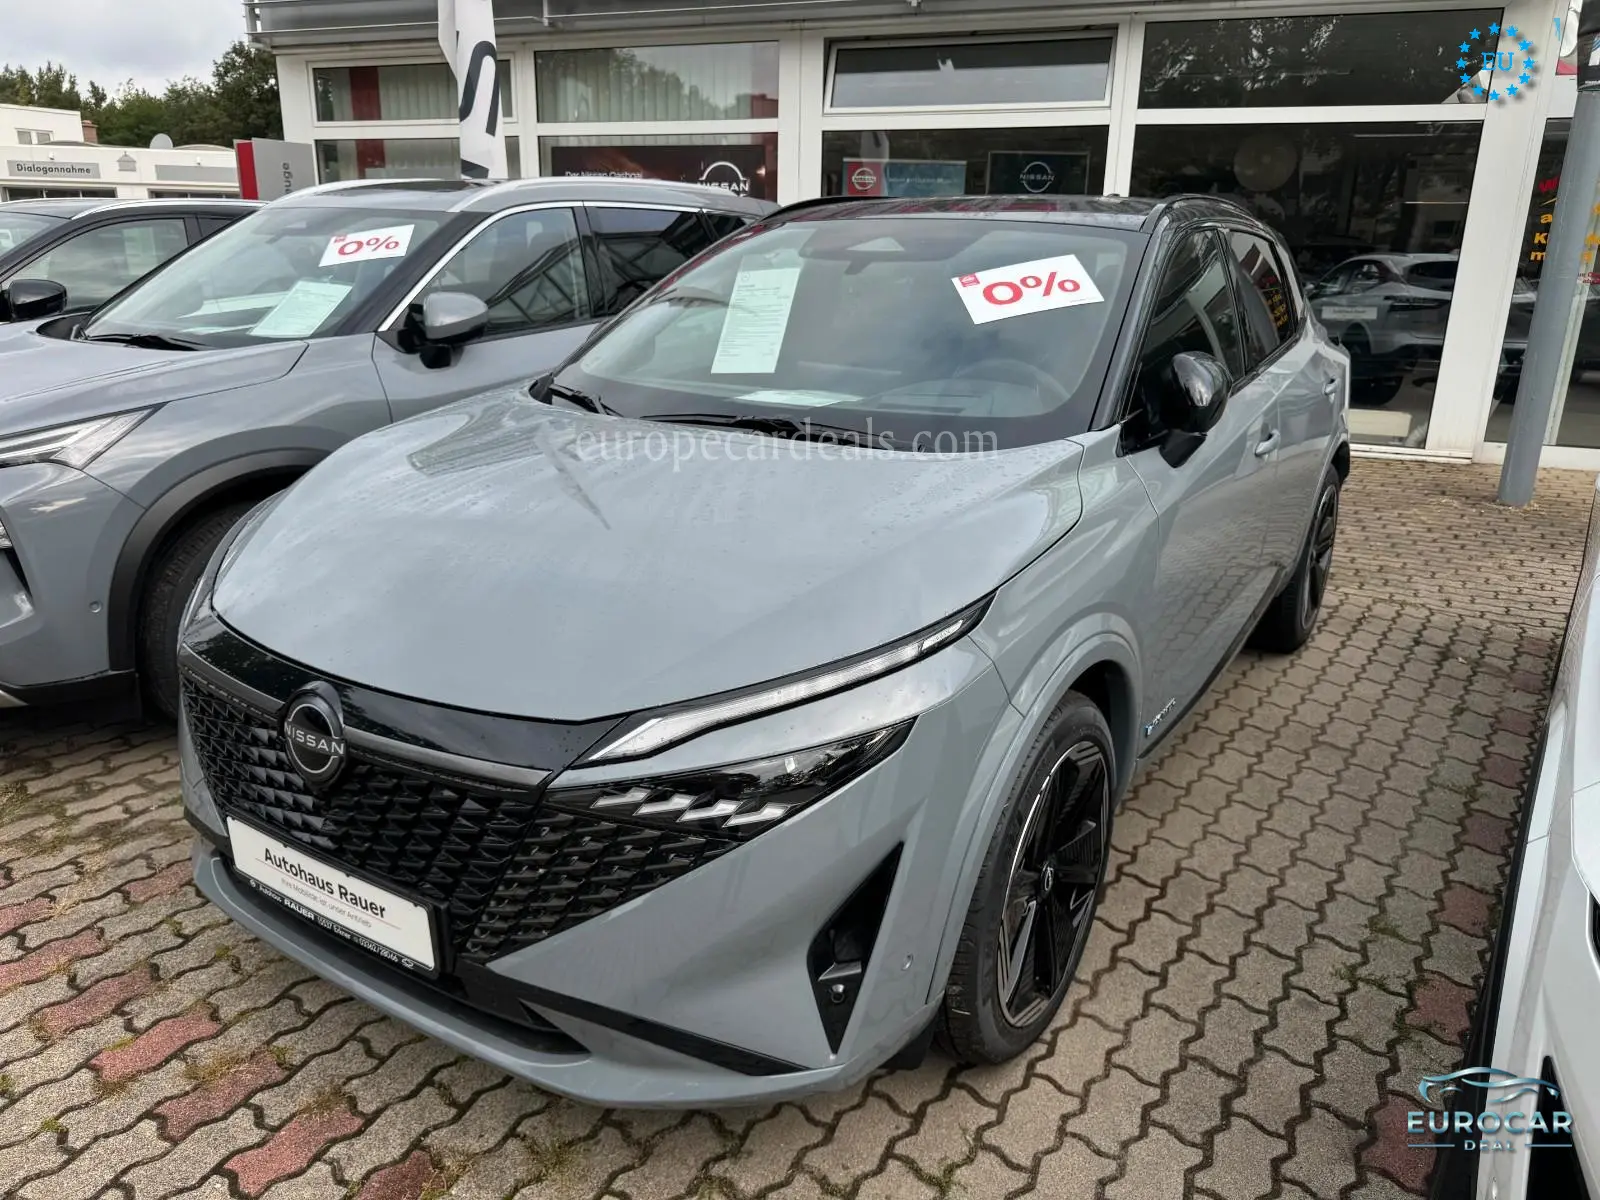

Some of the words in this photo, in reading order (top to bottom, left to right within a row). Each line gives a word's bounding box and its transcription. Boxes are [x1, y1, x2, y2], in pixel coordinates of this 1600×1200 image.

[16, 163, 91, 175] Dialogannahme
[338, 236, 399, 255] 0%
[983, 271, 1080, 305] 0%
[284, 721, 344, 755] NISSAN
[264, 848, 334, 895] Autohaus
[338, 884, 386, 919] Rauer
[284, 898, 315, 920] RAUER
